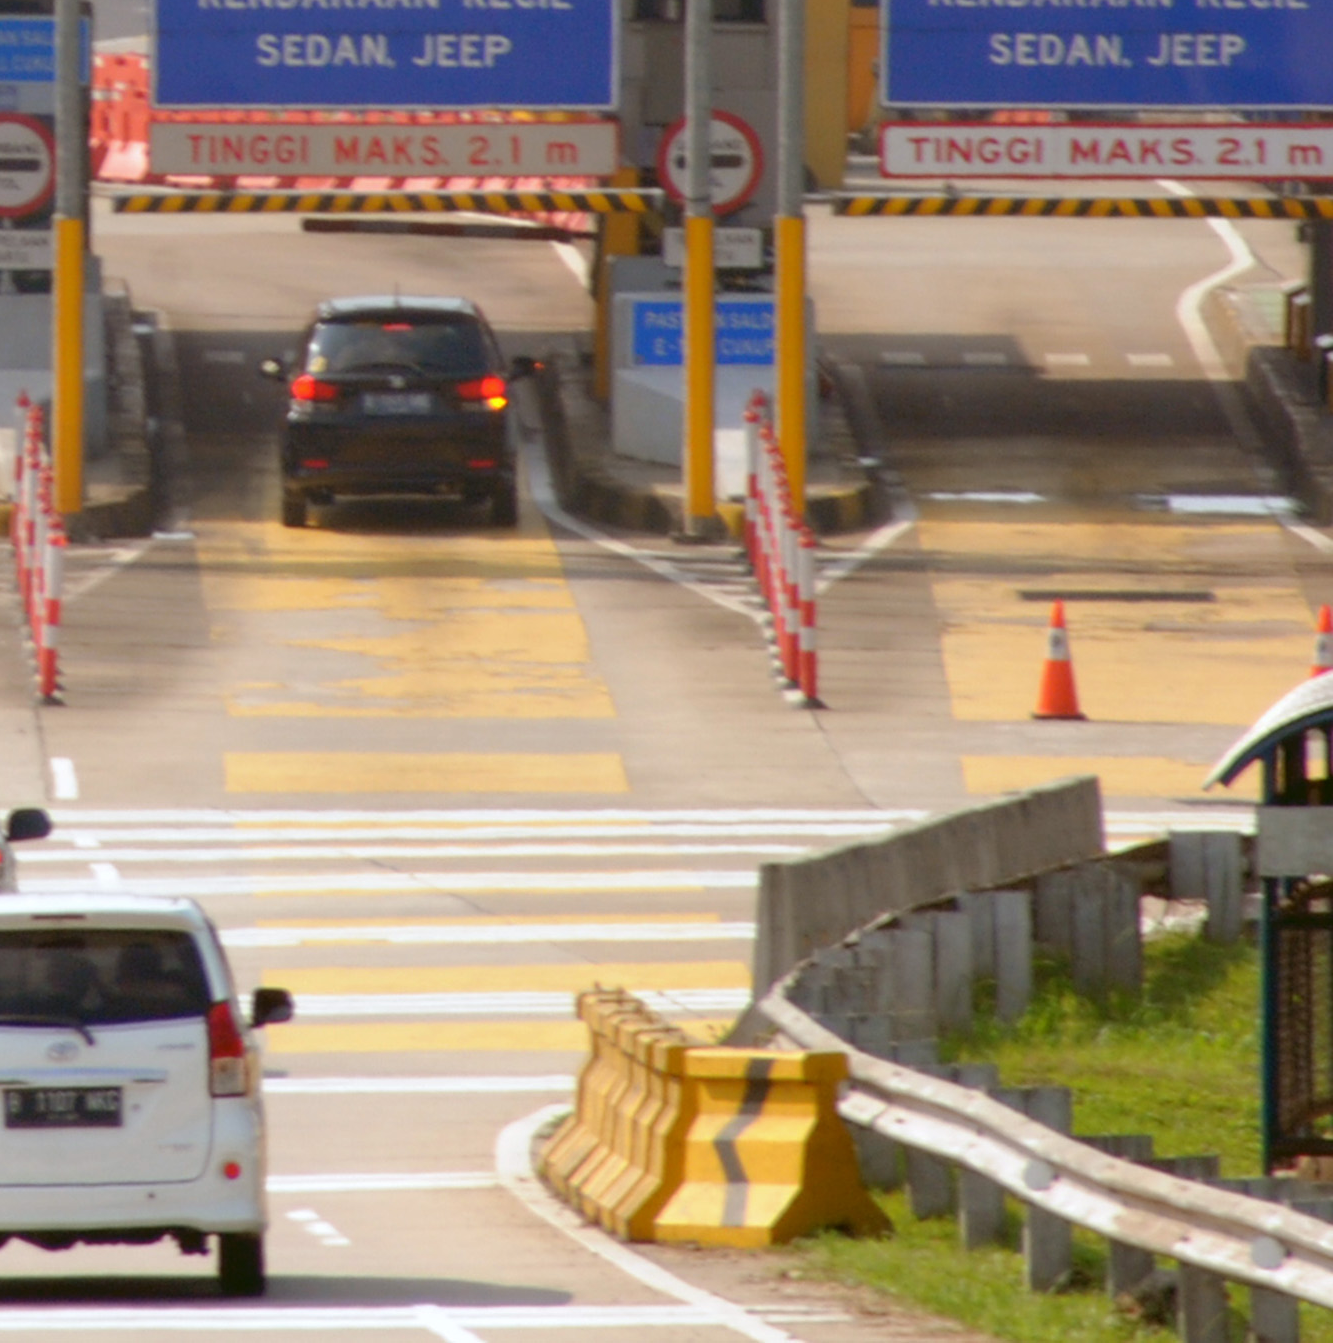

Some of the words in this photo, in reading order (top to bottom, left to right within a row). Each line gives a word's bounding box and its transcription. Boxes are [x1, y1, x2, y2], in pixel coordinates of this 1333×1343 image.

[411, 34, 512, 68] JEEP
[1145, 33, 1246, 67] JEEP
[185, 134, 310, 166] TINGGI
[545, 140, 581, 166] m
[906, 136, 1044, 166] TINGGI
[1288, 143, 1325, 166] m
